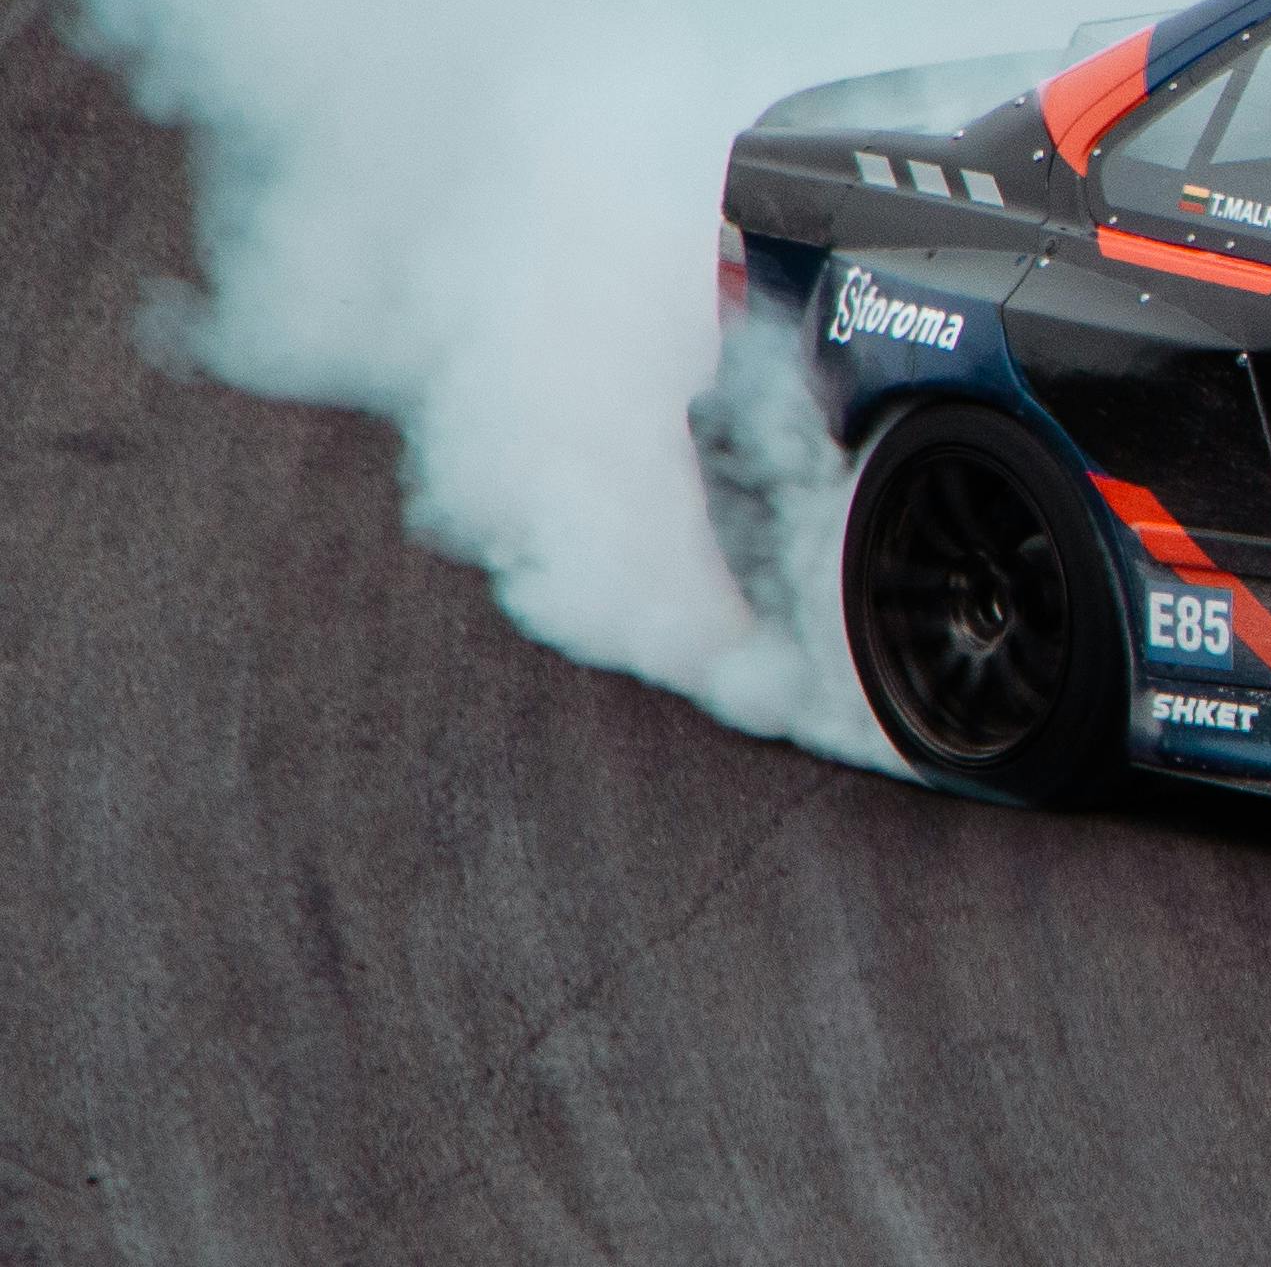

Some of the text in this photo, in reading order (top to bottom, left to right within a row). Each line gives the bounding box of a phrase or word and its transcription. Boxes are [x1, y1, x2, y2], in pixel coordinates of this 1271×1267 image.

[829, 265, 966, 351] Storoma
[1150, 591, 1230, 656] E85
[1152, 692, 1259, 731] SHKET
